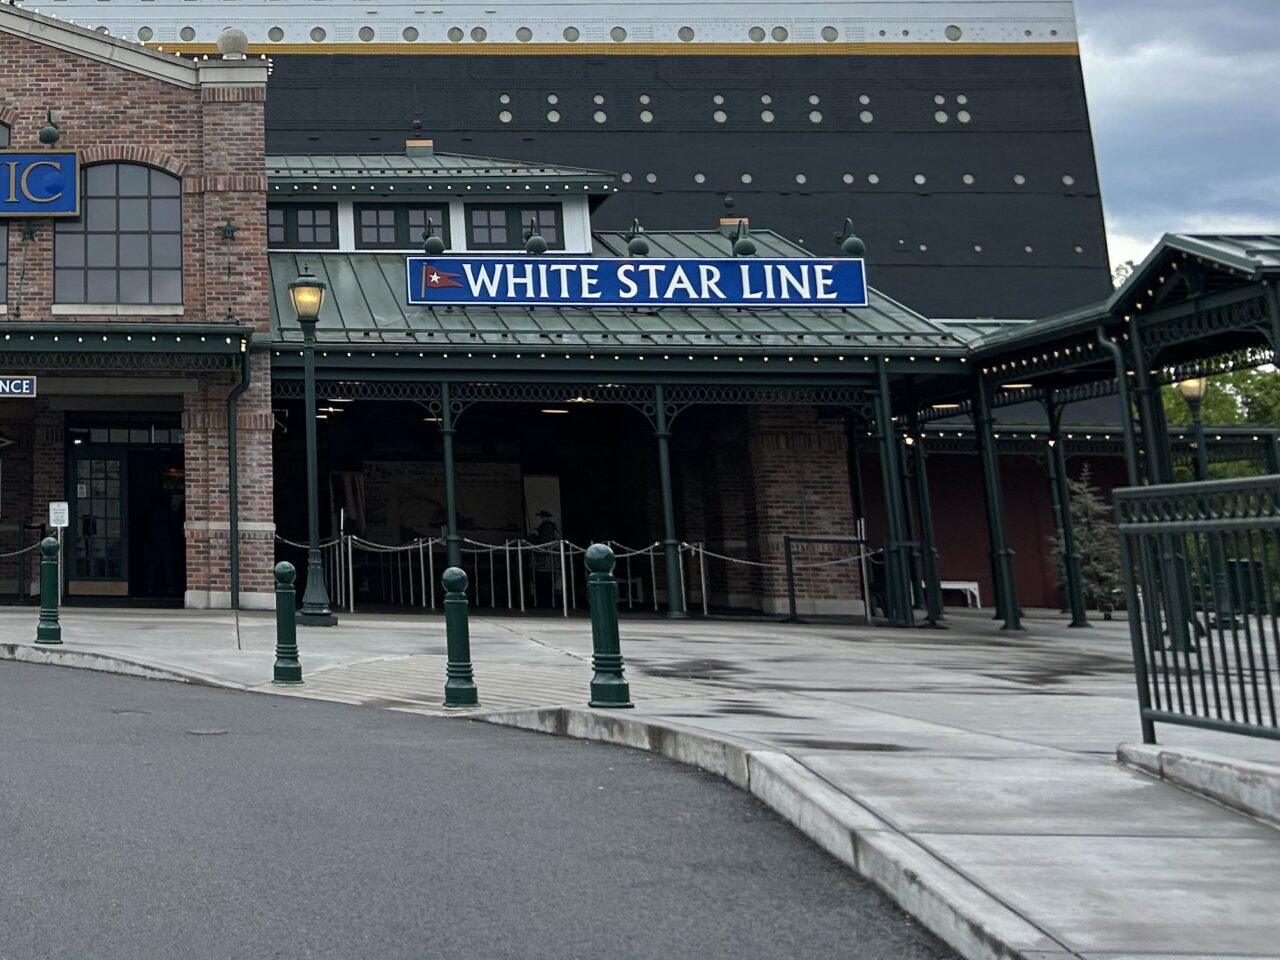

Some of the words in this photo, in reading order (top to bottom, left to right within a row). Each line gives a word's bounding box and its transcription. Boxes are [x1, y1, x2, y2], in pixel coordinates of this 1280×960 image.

[462, 263, 602, 298] WHITE
[617, 264, 727, 299] STAR
[739, 264, 838, 299] LINE
